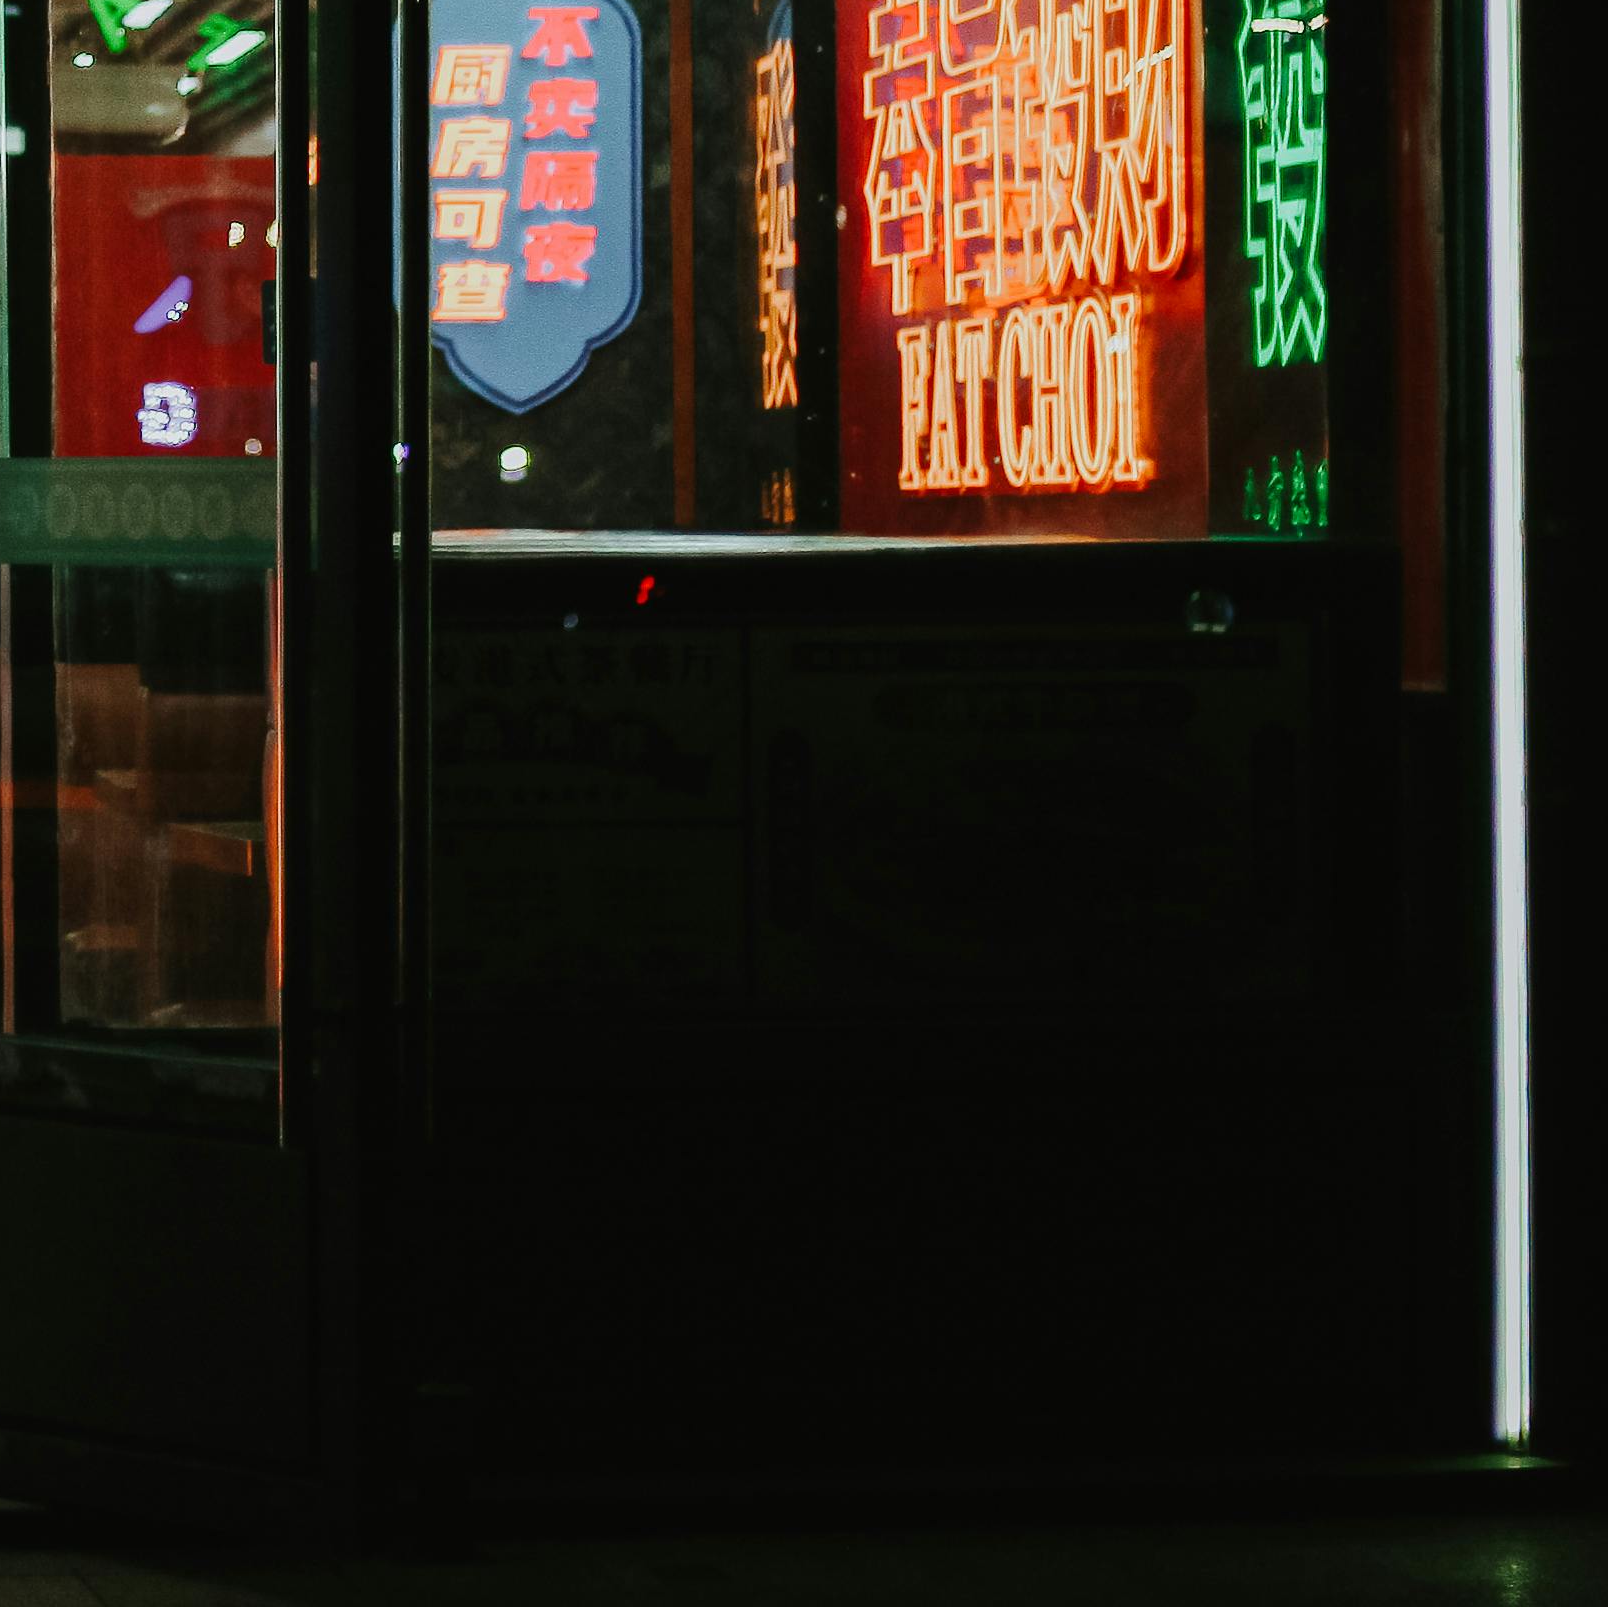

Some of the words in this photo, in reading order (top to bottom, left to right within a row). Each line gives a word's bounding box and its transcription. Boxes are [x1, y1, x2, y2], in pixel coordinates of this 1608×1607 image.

[431, 44, 512, 322] 厨房可查
[897, 318, 992, 490] FAT
[996, 292, 1143, 488] CHOI
